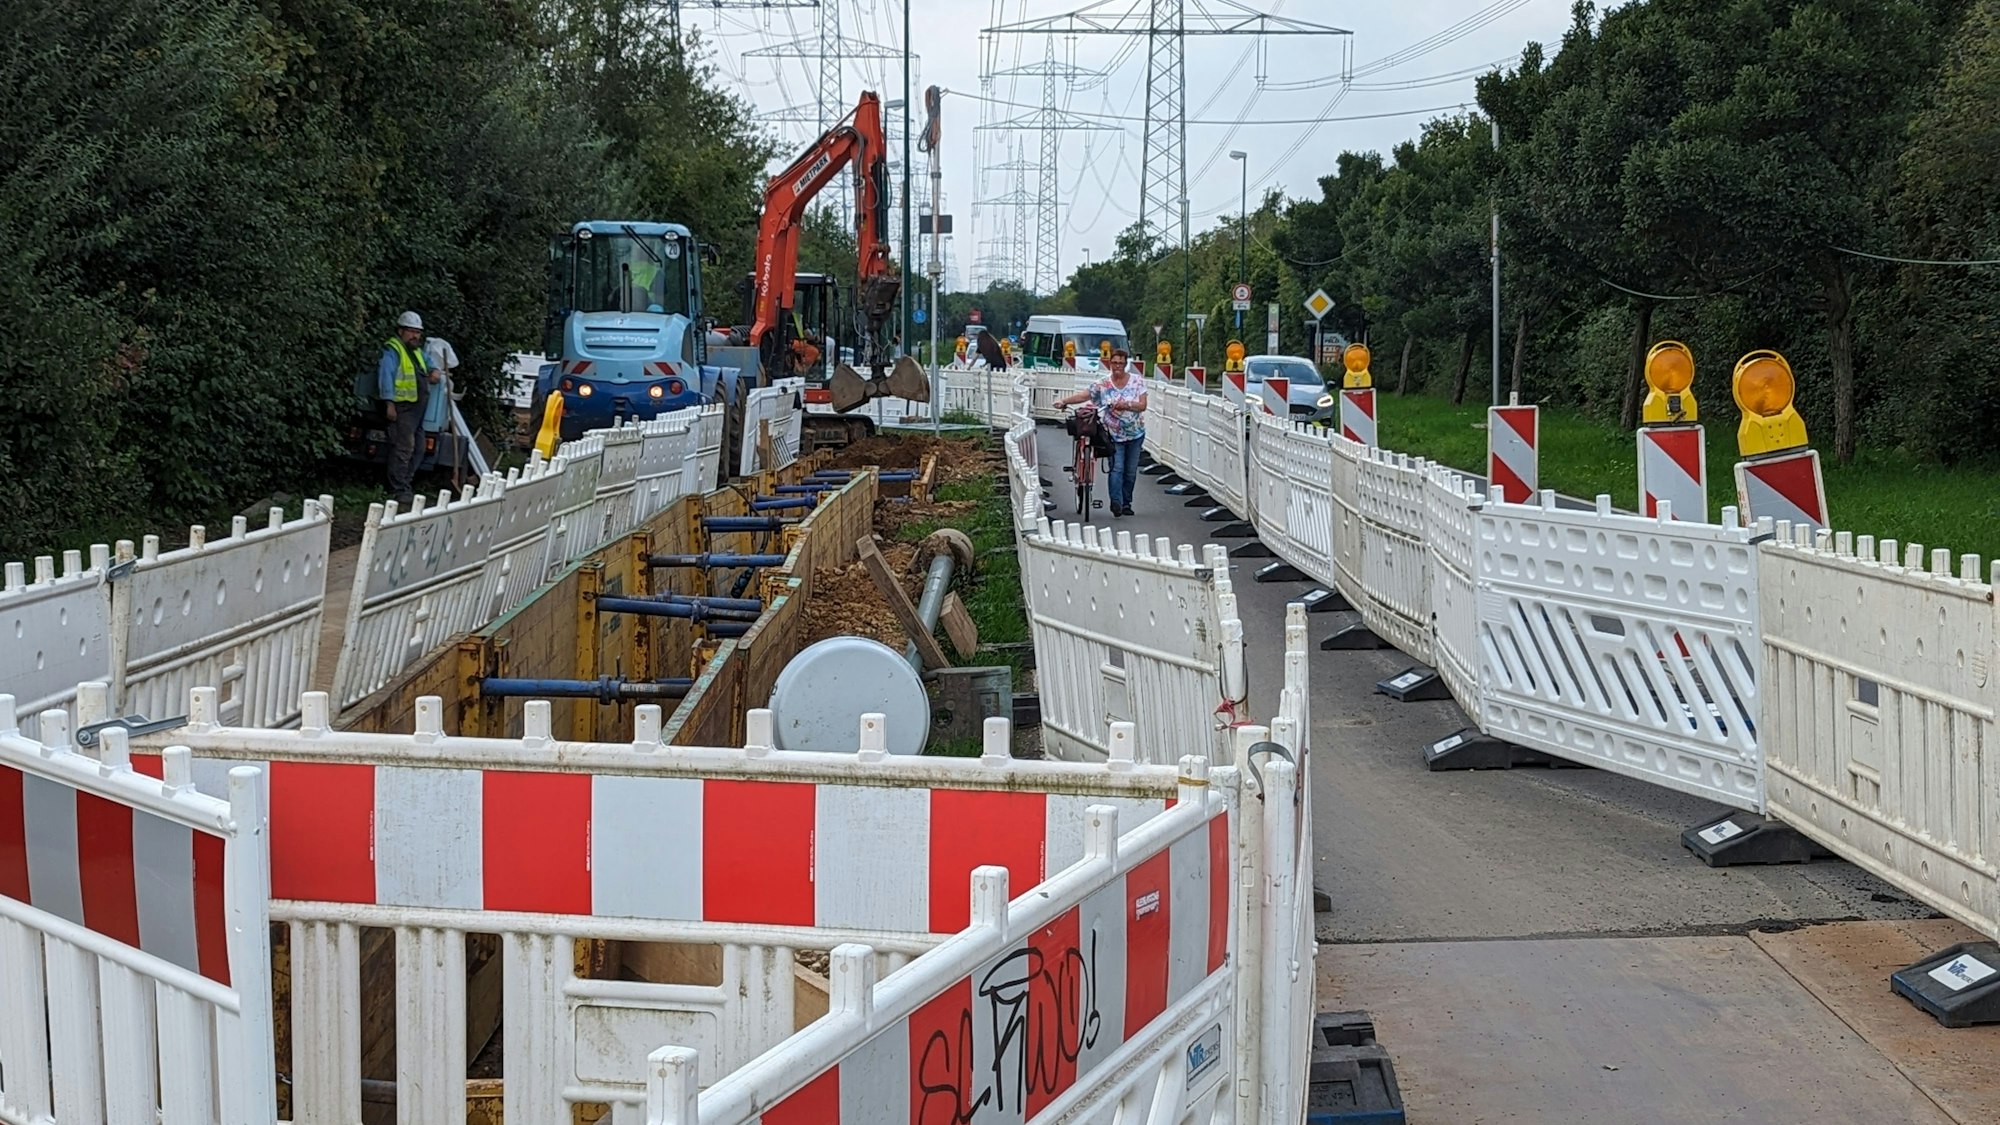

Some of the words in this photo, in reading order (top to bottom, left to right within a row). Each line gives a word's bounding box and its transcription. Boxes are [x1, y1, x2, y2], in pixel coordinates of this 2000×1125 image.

[798, 155, 829, 188] MIETPARK
[668, 243, 678, 256] 20
[760, 253, 772, 297] Kubota
